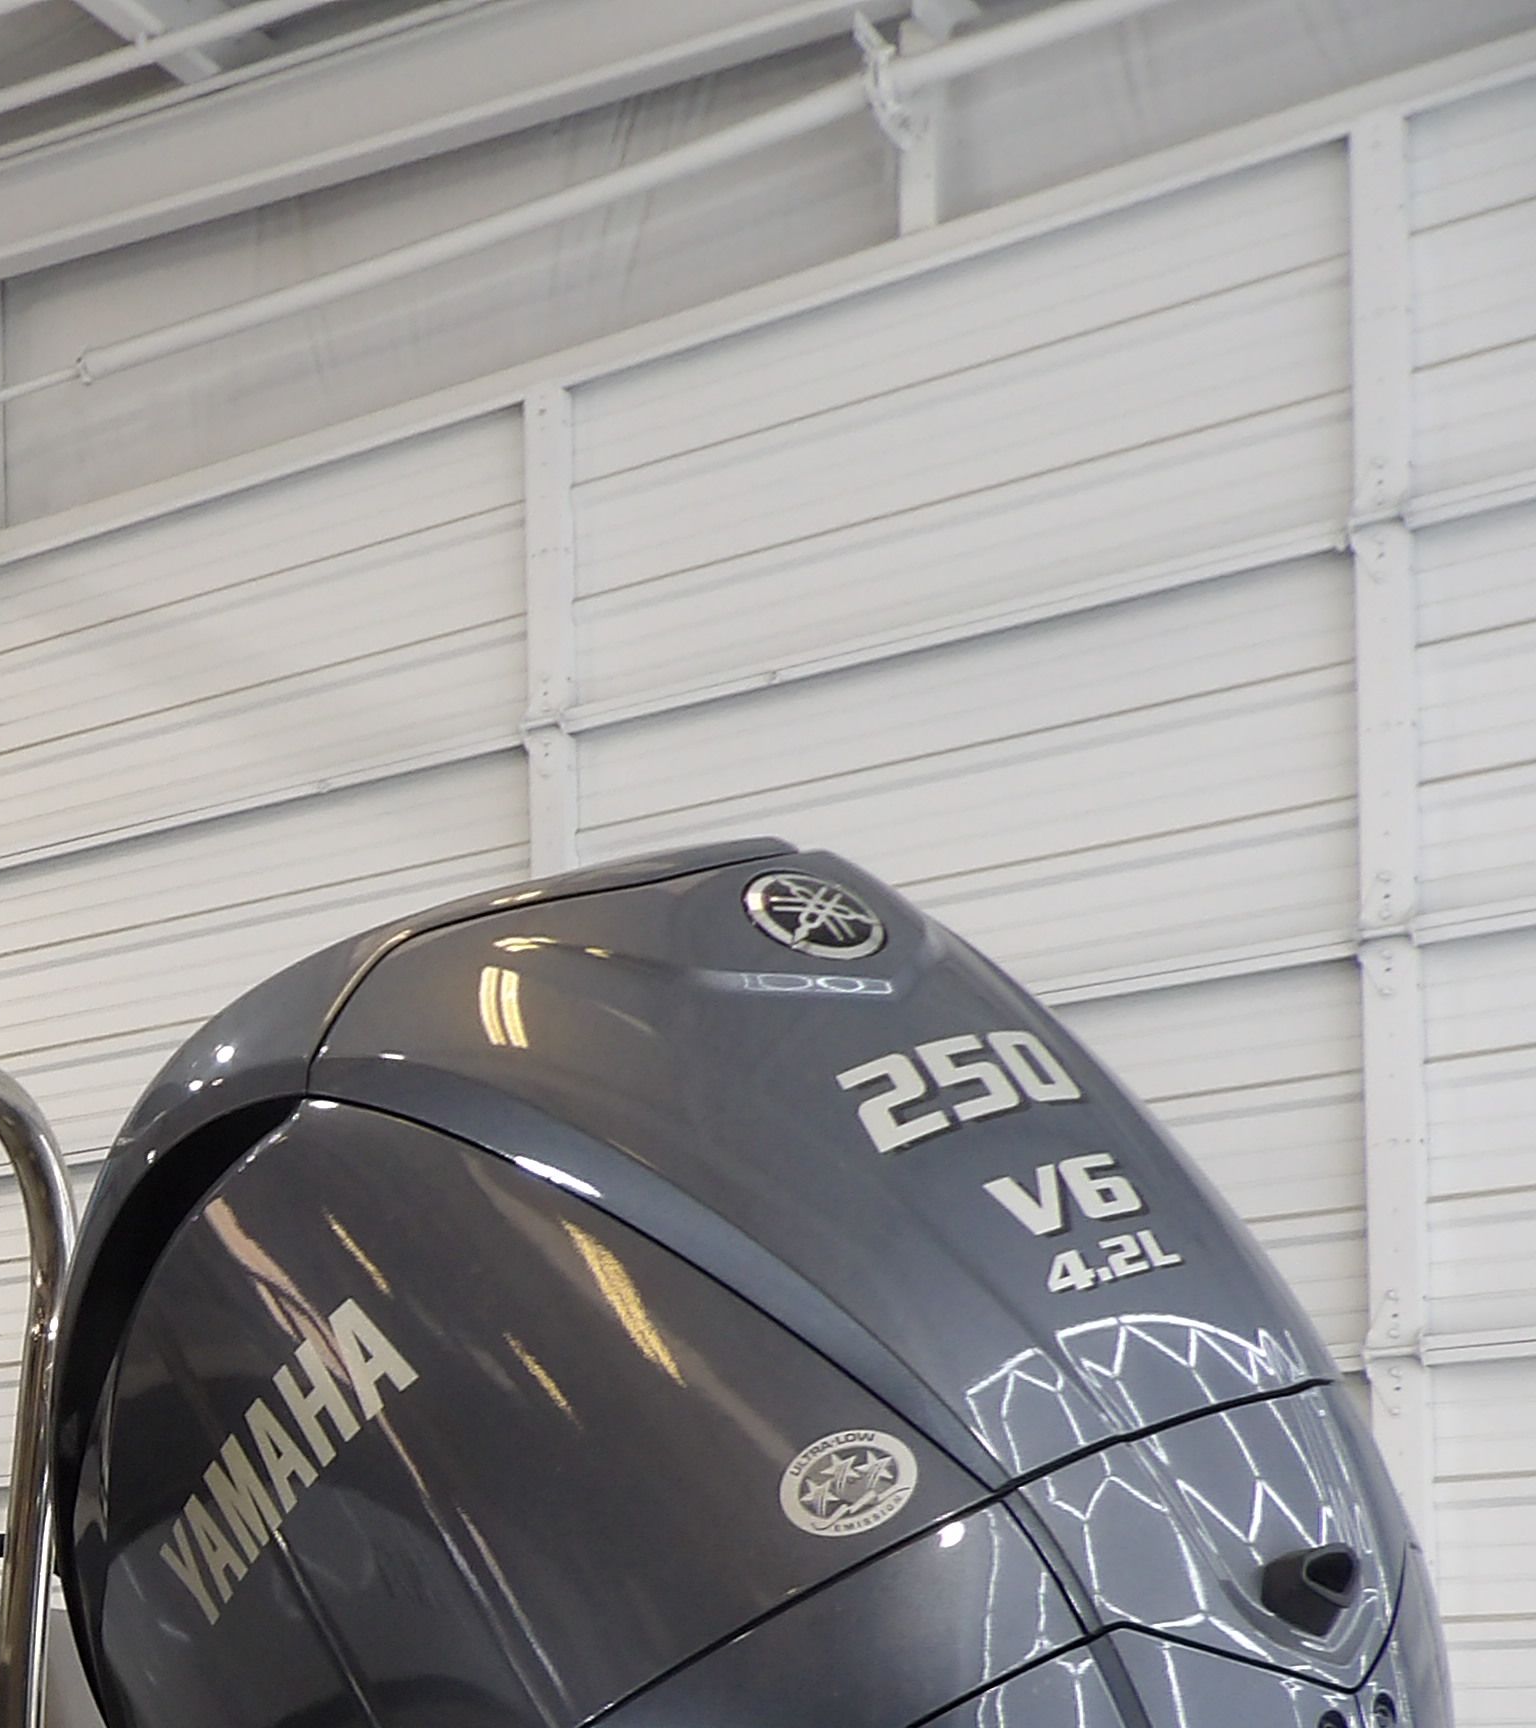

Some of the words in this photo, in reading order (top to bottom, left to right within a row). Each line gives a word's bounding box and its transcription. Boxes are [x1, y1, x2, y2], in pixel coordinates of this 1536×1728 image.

[836, 1030, 1082, 1154] 250
[982, 1152, 1144, 1235] V6
[1047, 1229, 1183, 1293] 4.2L
[160, 1298, 420, 1626] YAMAHA
[789, 1433, 875, 1477] ULTRA-LOW
[833, 1495, 902, 1532] EMISSION
